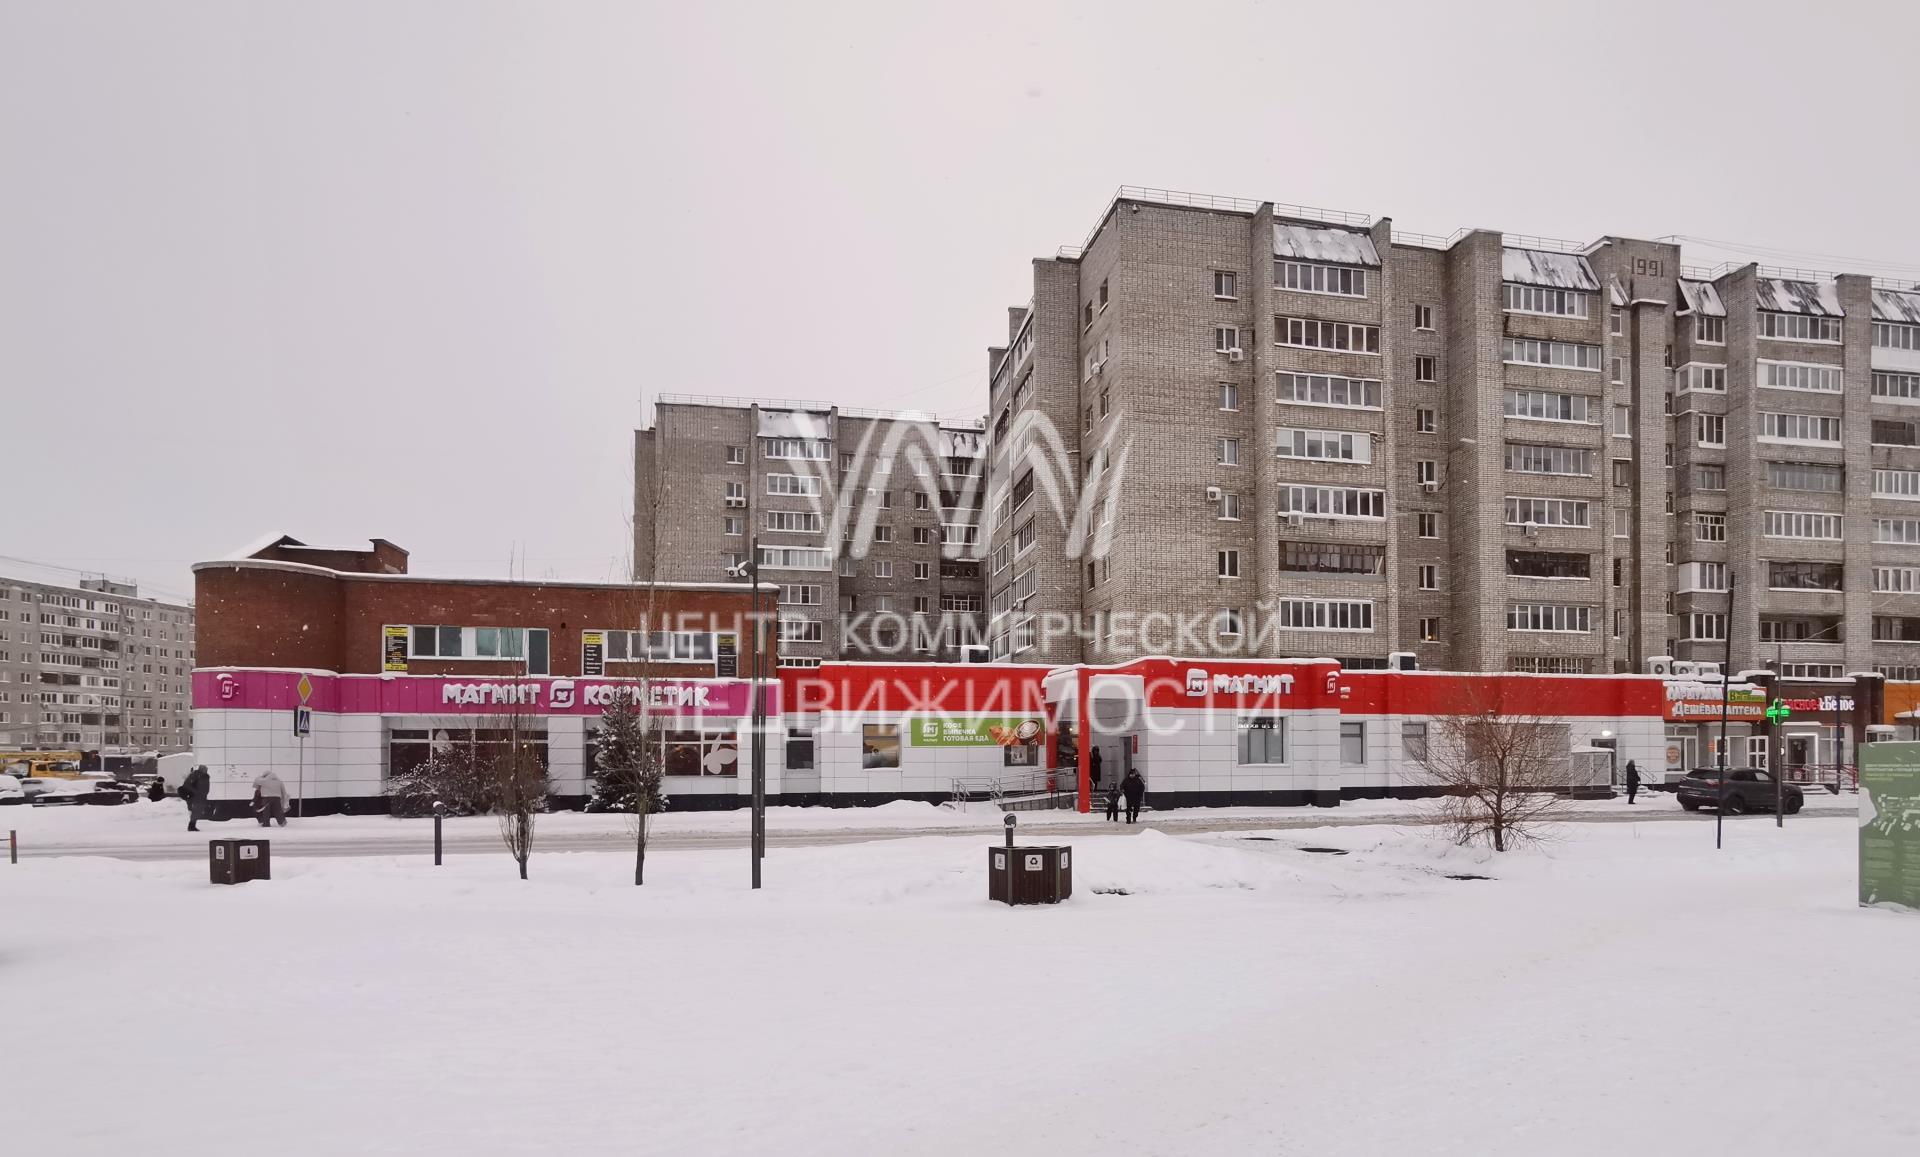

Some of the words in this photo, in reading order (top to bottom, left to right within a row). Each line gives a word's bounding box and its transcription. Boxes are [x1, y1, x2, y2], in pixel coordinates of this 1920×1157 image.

[1631, 255, 1664, 278] 1991
[442, 683, 541, 705] МАГНИТ
[1213, 674, 1295, 694] МАГНИТ
